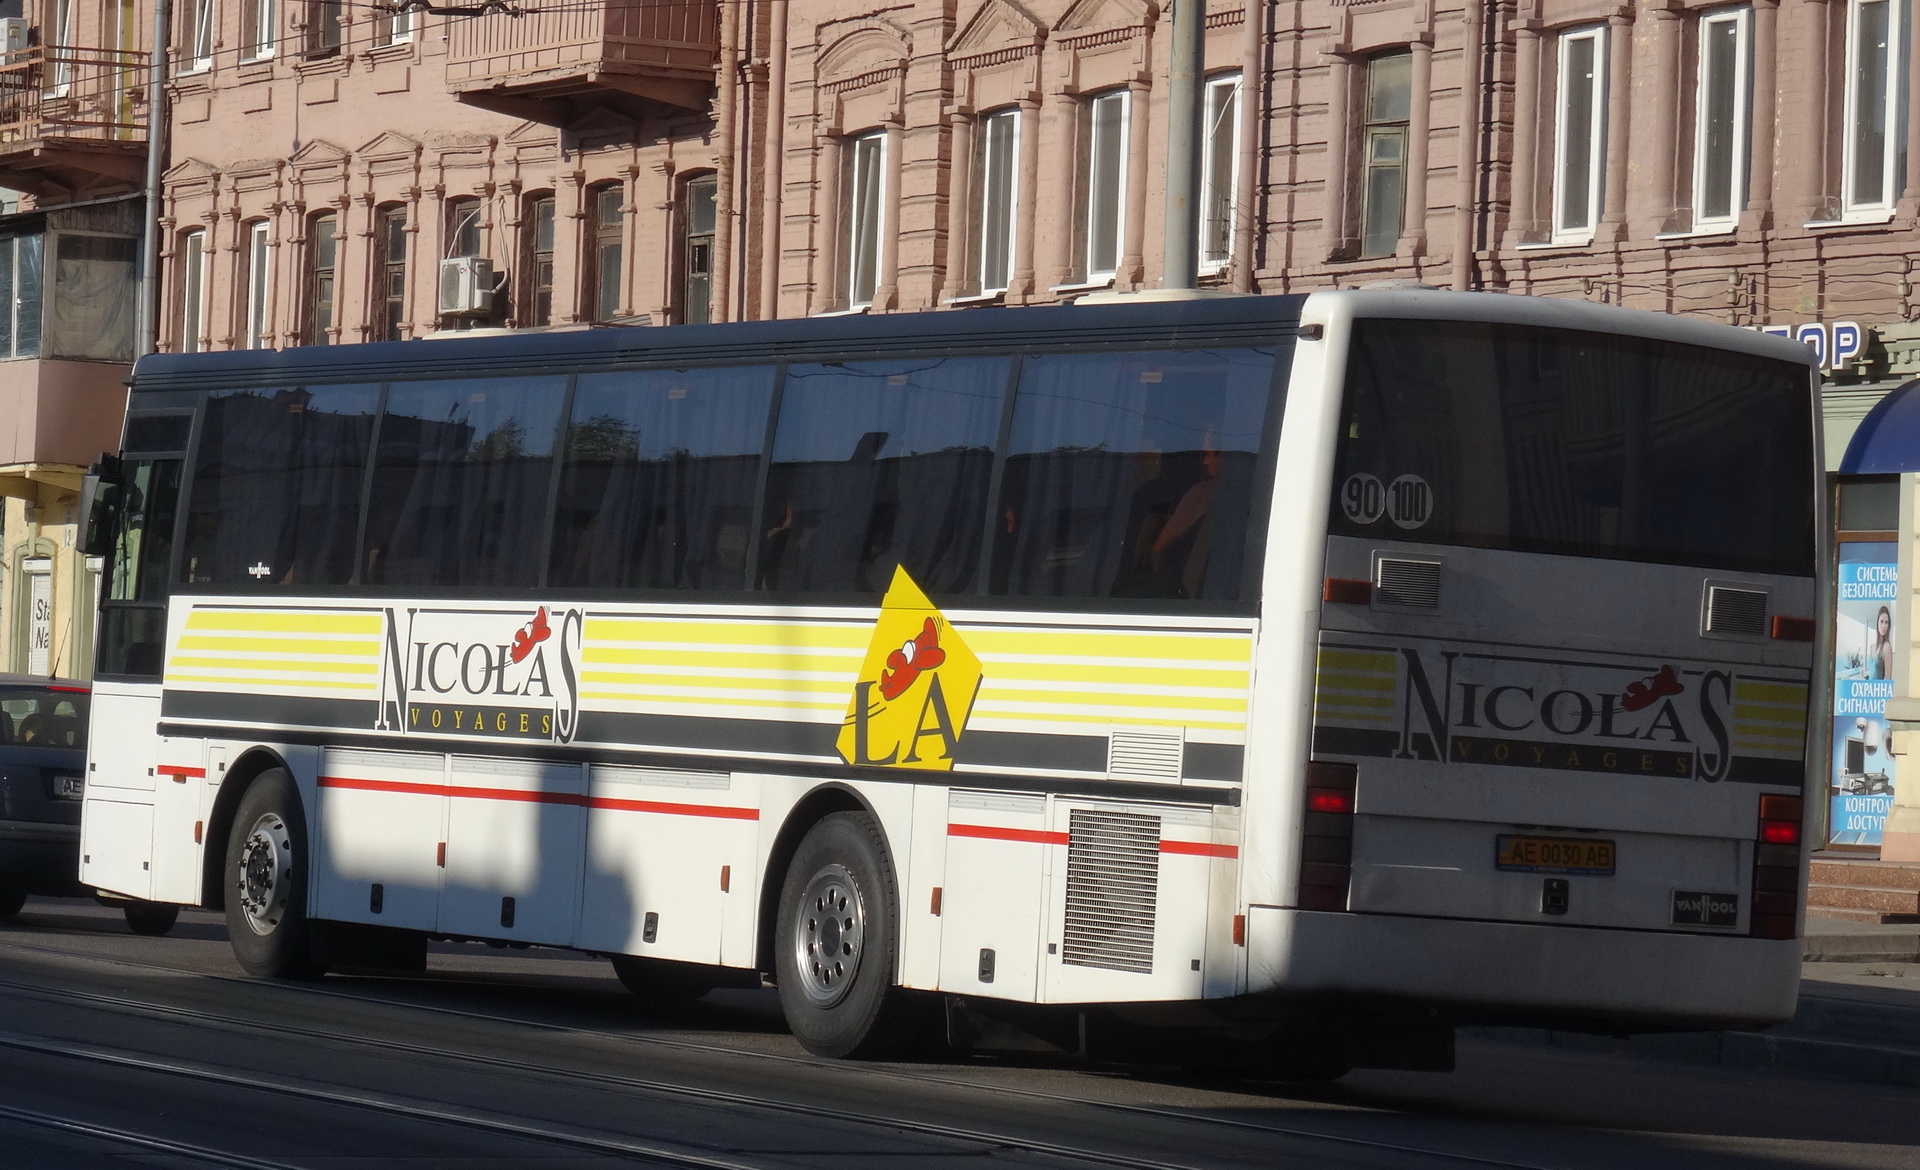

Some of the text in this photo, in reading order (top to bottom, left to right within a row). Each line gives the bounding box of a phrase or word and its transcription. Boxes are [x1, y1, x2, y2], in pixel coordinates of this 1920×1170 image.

[1347, 477, 1379, 518] 90
[1393, 481, 1427, 522] 100
[1842, 583, 1897, 598] БЕЗОПАСНО
[1851, 682, 1893, 698] ОХРАННА
[854, 671, 954, 766] LA
[1838, 699, 1886, 714] СИГНАЛИЗ
[410, 708, 551, 734] VOYAGES
[1457, 741, 1688, 774] VOYAGES
[63, 779, 82, 794] AE
[1512, 842, 1610, 866] AE 0030 AB
